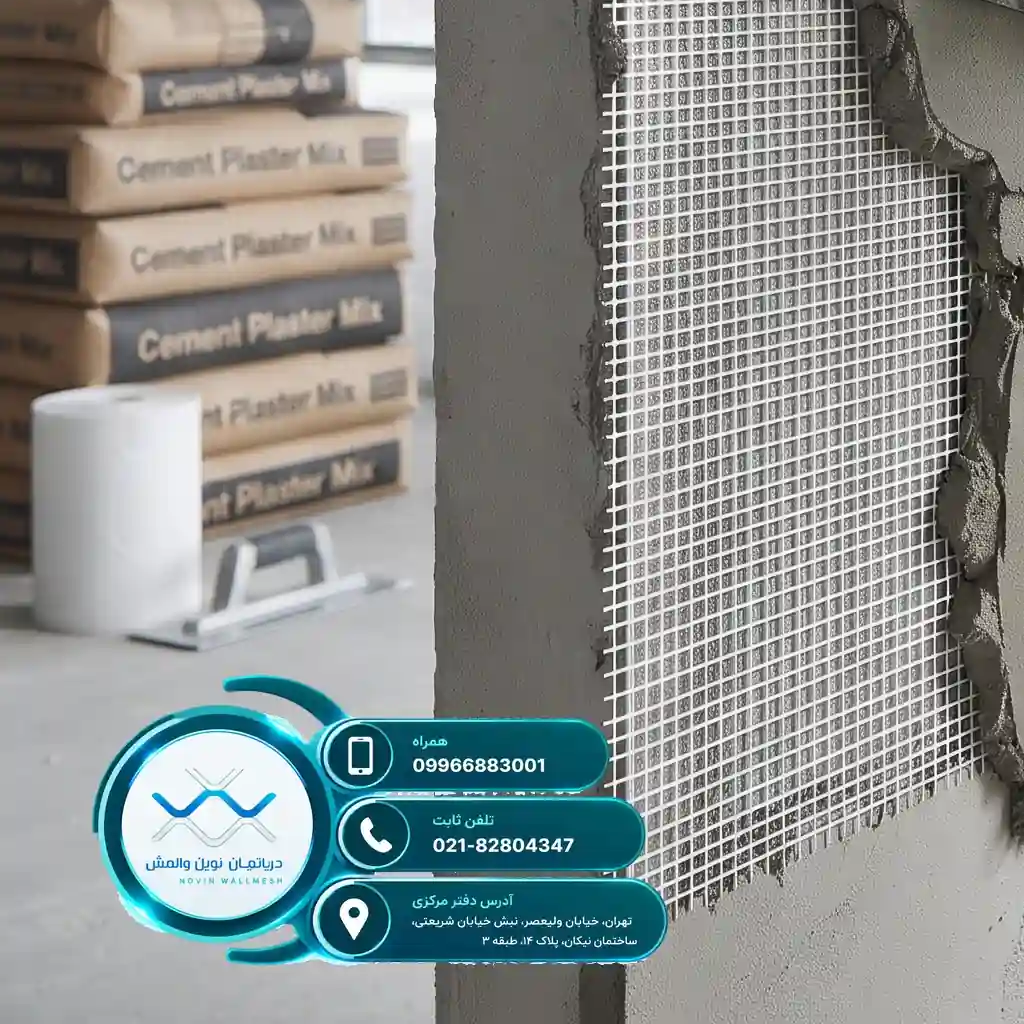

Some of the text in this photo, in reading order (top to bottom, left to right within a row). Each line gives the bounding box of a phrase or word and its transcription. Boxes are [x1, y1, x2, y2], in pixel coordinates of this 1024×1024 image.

[117, 141, 347, 184] Cement Plaster Mix
[131, 221, 356, 273] Cement Plaster Mix
[138, 295, 384, 363] Cement Plaster Mix
[317, 378, 355, 406] Mix
[236, 474, 326, 517] Plaster
[330, 457, 378, 491] Mix
